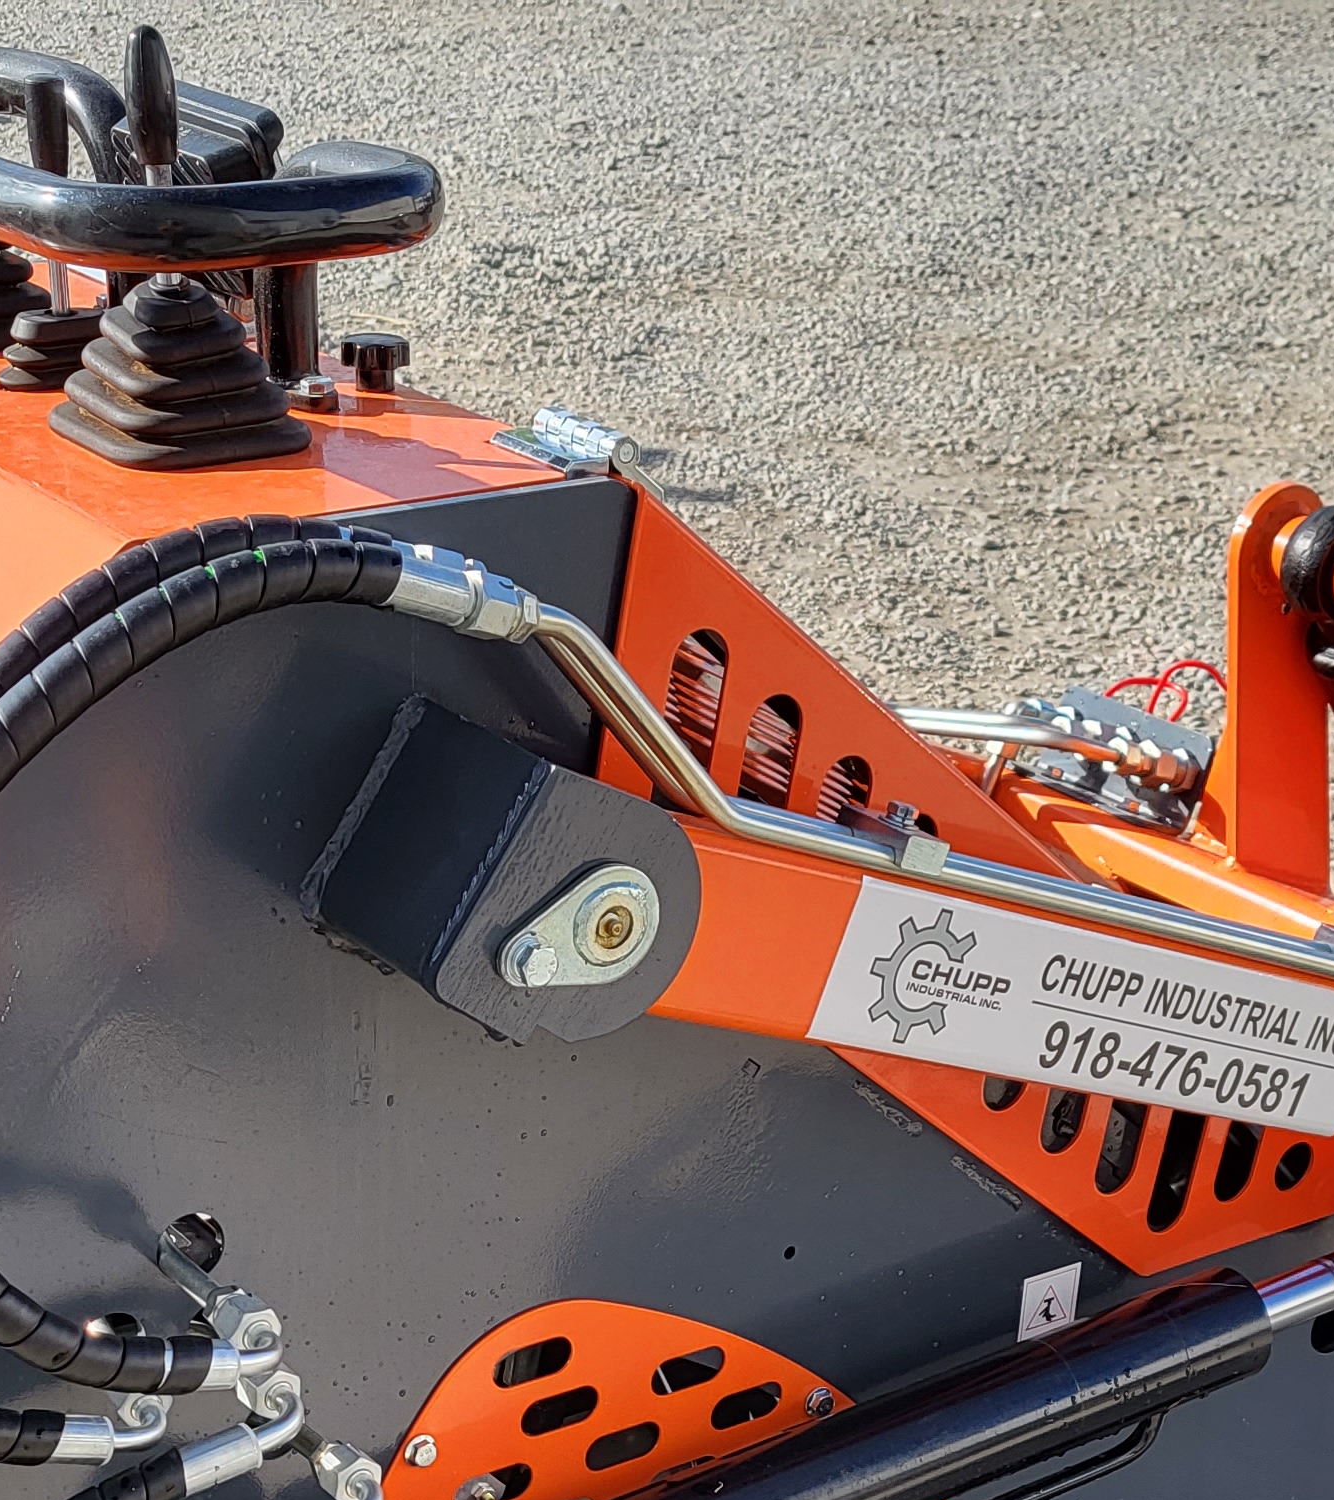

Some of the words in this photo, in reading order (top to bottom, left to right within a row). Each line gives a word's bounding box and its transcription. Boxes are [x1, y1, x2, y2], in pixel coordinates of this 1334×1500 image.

[906, 982, 978, 1006] INDUSTRIAL
[979, 998, 1002, 1011] INC.
[912, 959, 1012, 996] CHUPP
[1040, 954, 1145, 1009] CHUPP
[1144, 978, 1299, 1047] INDUSTRIAL
[1039, 1020, 1311, 1117] 918-476-0581
